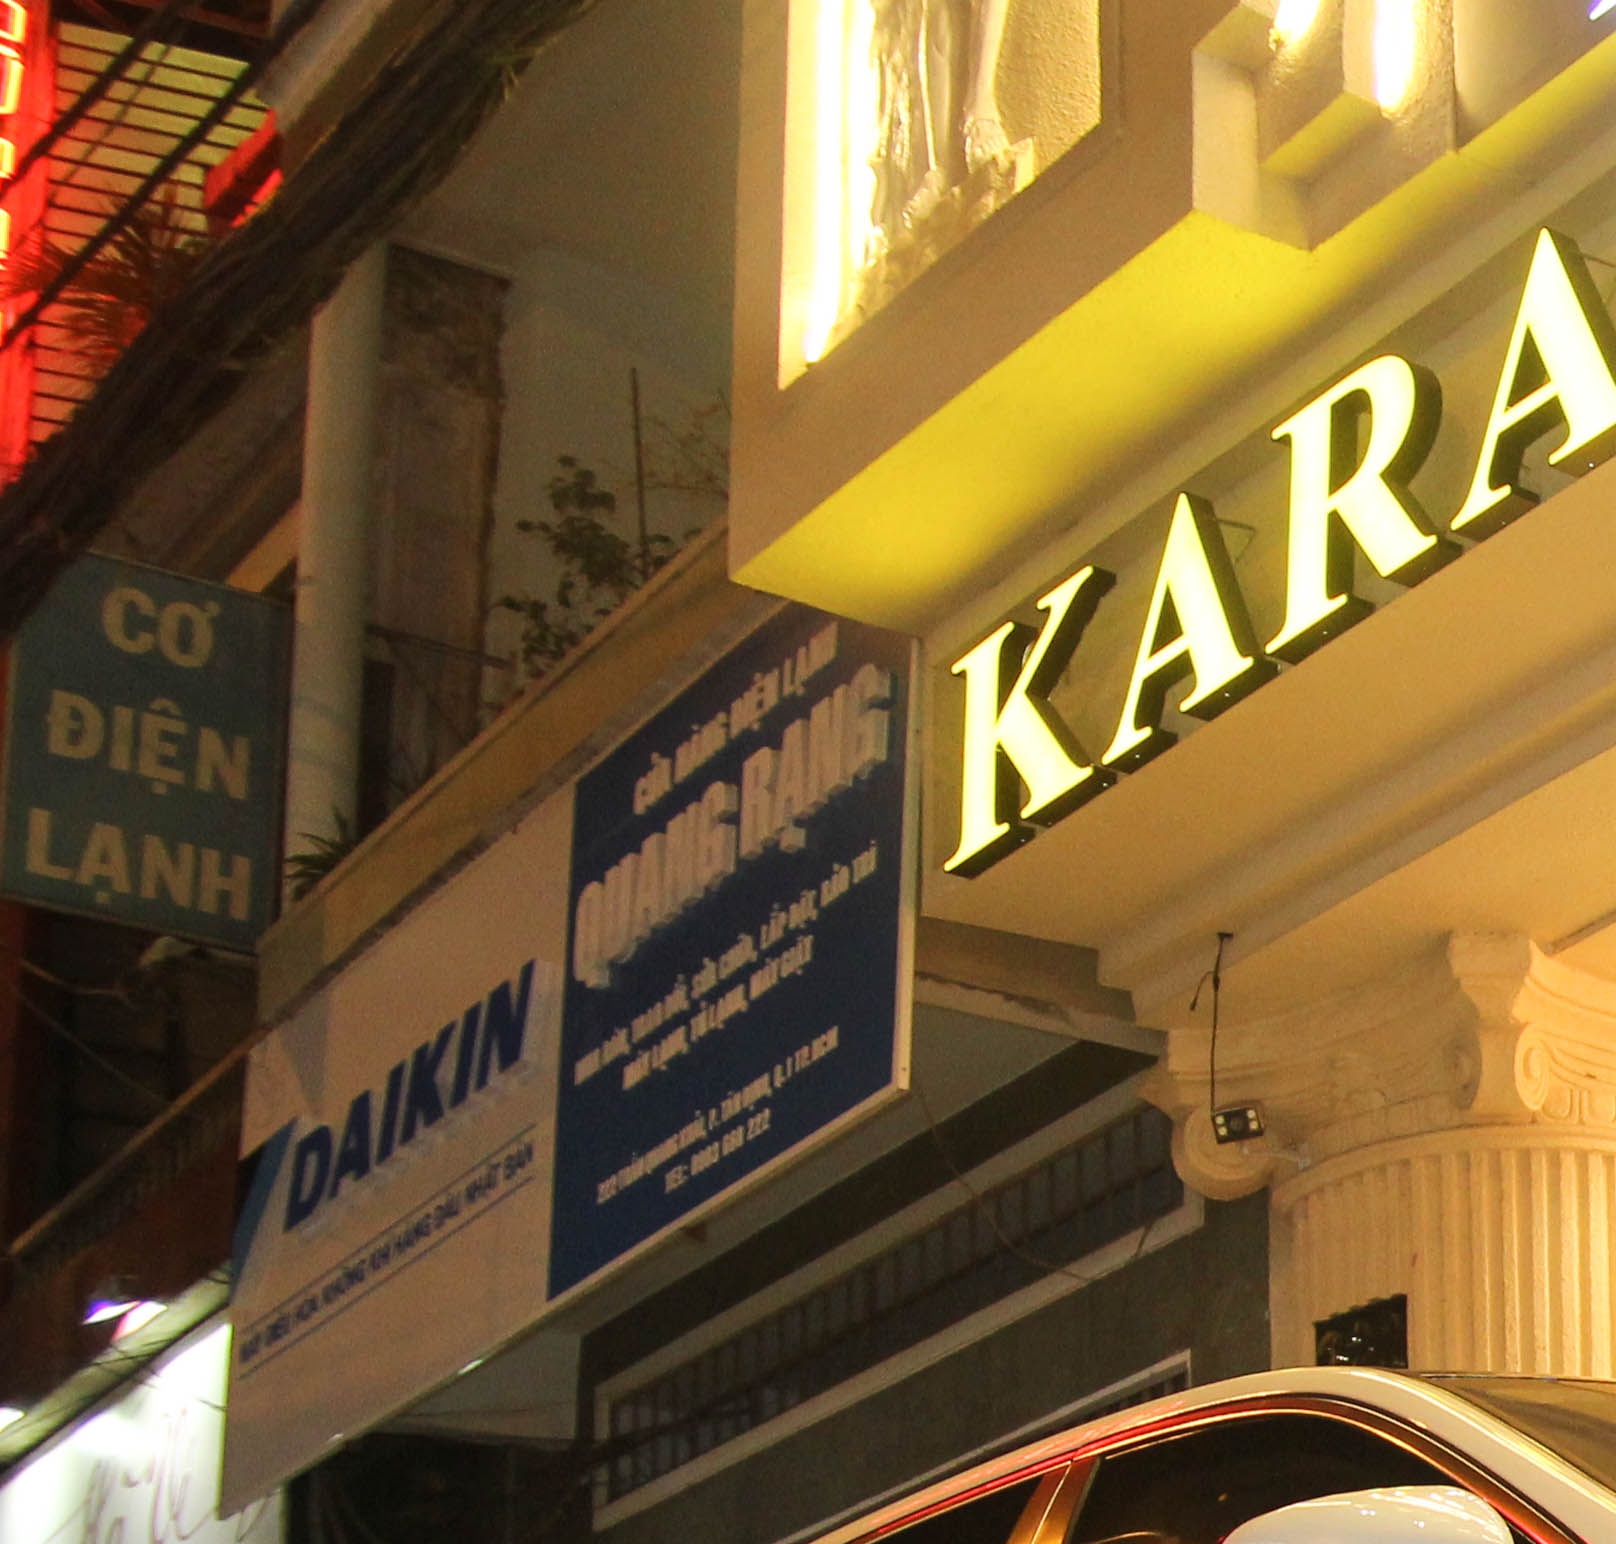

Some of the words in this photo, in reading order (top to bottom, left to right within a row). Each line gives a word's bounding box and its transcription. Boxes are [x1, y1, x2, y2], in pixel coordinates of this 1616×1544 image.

[103, 586, 222, 668] CƠ
[46, 689, 250, 801] ĐIỆN
[24, 807, 251, 921] LẠNH
[283, 957, 536, 1234] DAIKIN
